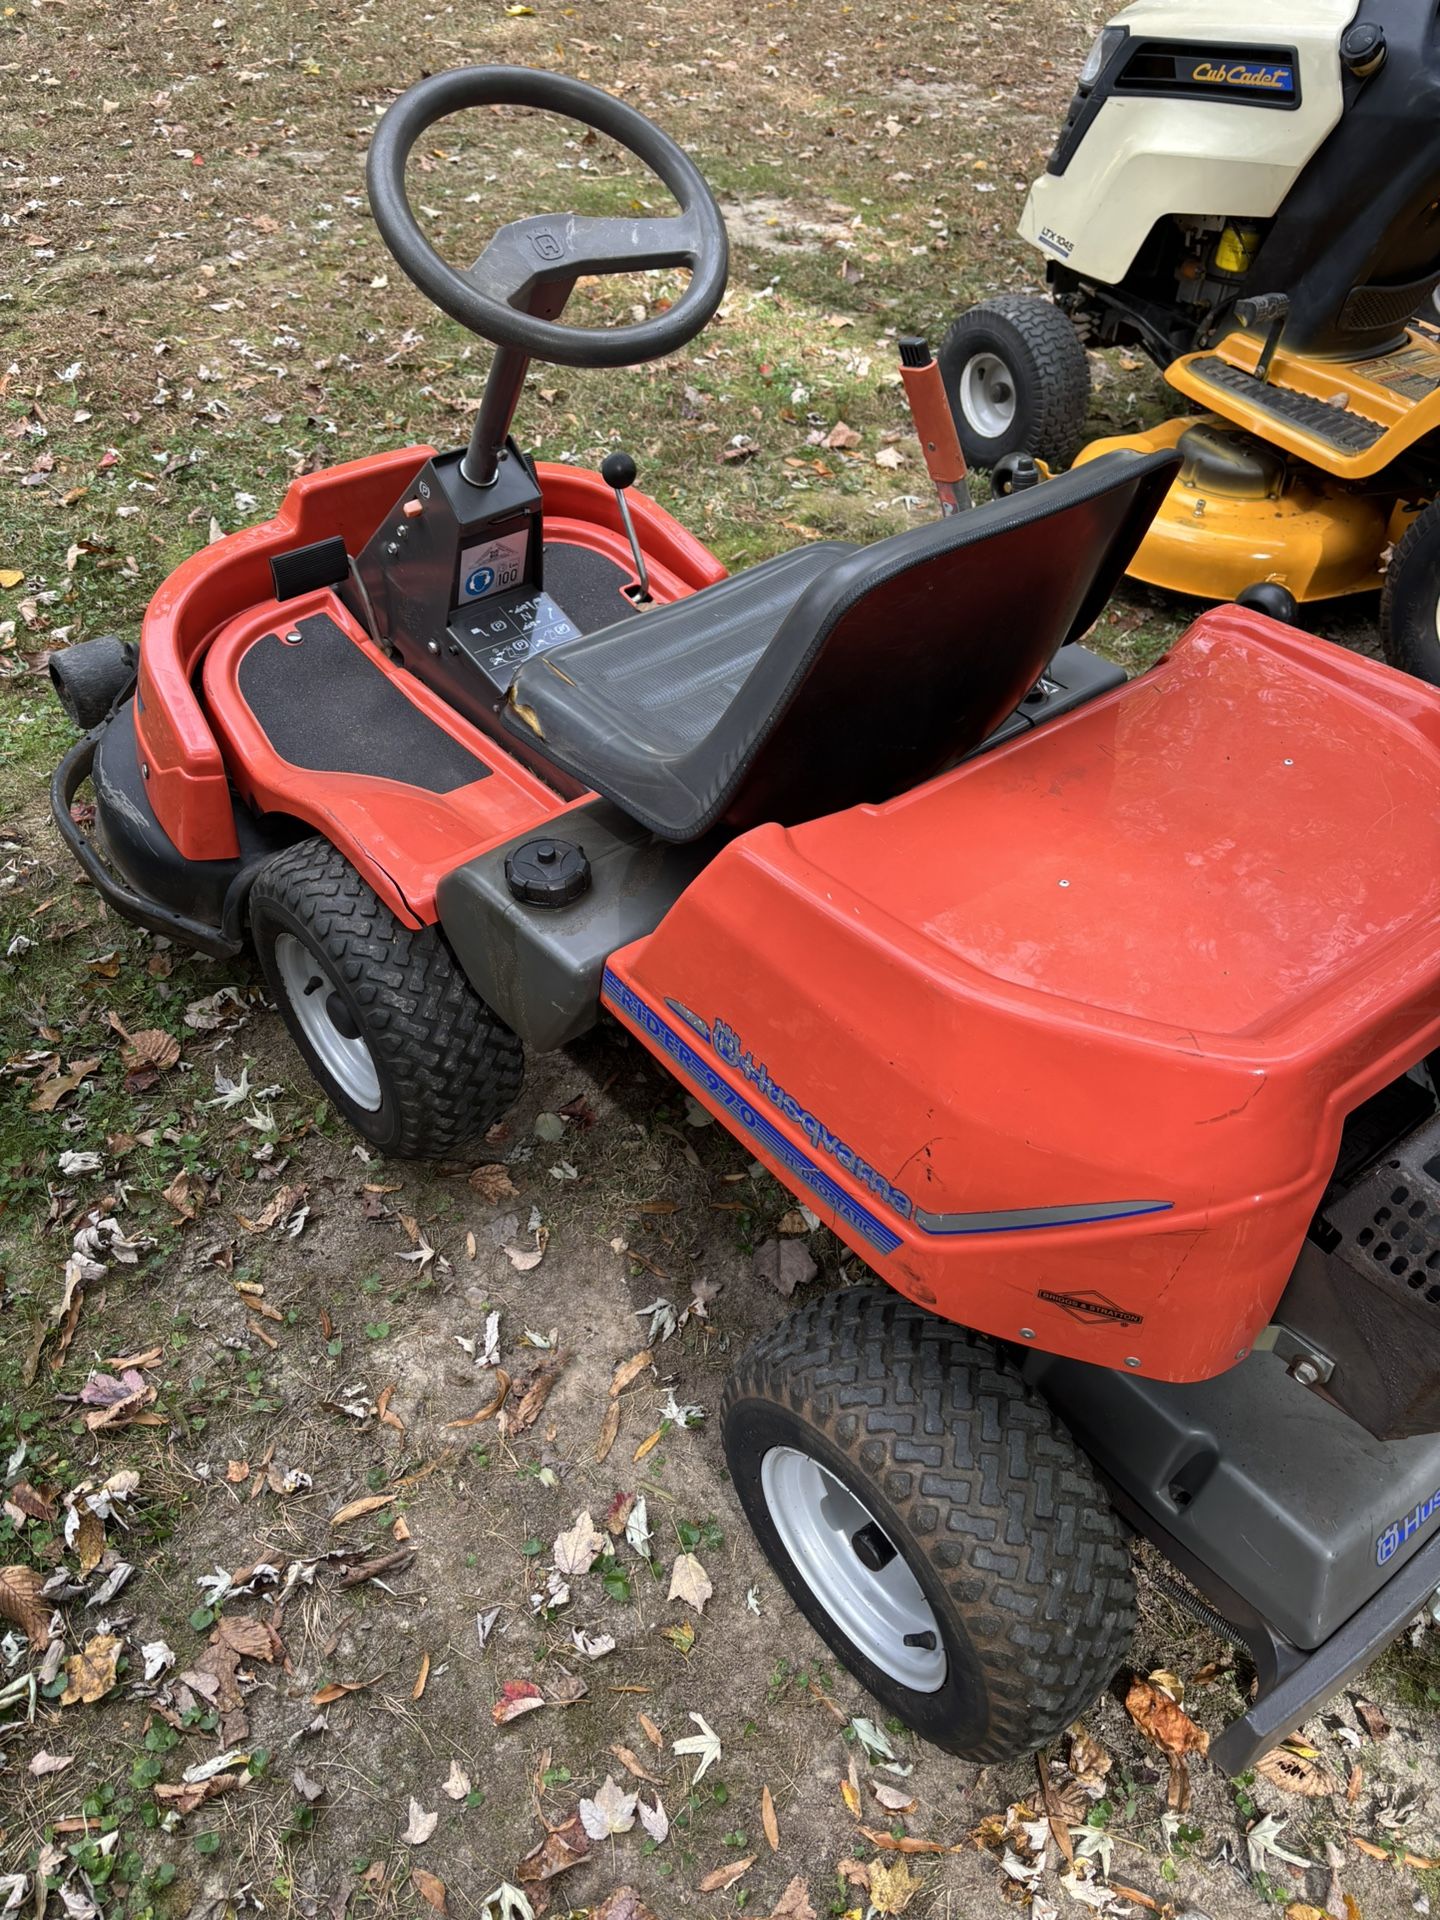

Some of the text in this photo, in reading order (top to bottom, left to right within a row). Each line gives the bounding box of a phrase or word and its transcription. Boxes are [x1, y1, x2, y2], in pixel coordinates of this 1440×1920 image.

[1193, 63, 1289, 88] Cub Cadet
[1041, 226, 1075, 252] LTX 1045
[498, 568, 518, 586] 100
[620, 988, 874, 1237] RIDER 970 HYDROSTATIC
[738, 1051, 913, 1220] Husqvarna
[1042, 1292, 1079, 1307] BRIGGS
[1089, 1305, 1138, 1322] STRATTON
